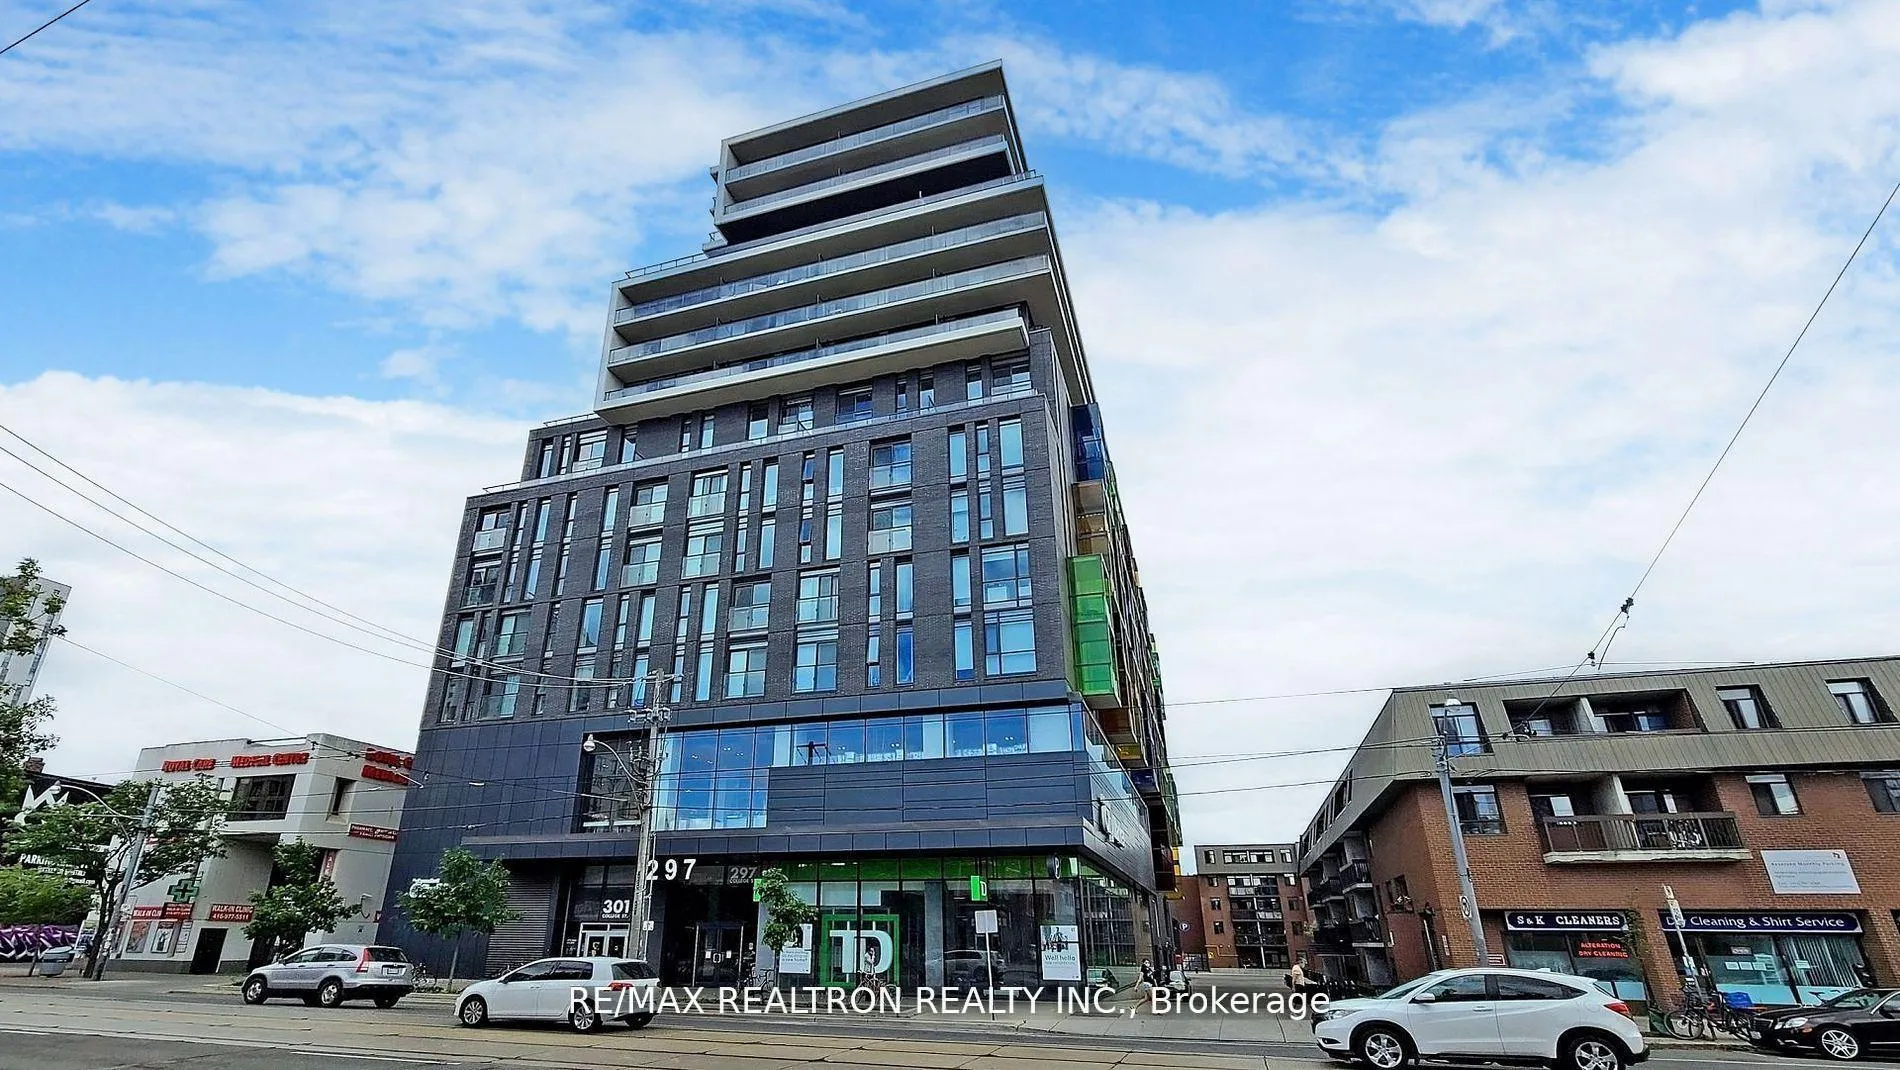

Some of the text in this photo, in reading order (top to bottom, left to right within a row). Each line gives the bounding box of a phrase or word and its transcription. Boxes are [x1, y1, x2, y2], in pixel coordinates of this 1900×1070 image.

[645, 858, 697, 881] 297
[729, 866, 758, 879] 297
[602, 899, 630, 914] 301
[1517, 915, 1620, 925] S & K CLEANERS
[1690, 916, 1747, 929] Cleaning
[1750, 917, 1761, 927] &
[1764, 916, 1793, 927] Shirt
[1796, 917, 1845, 928] Service
[829, 929, 893, 974] TD
